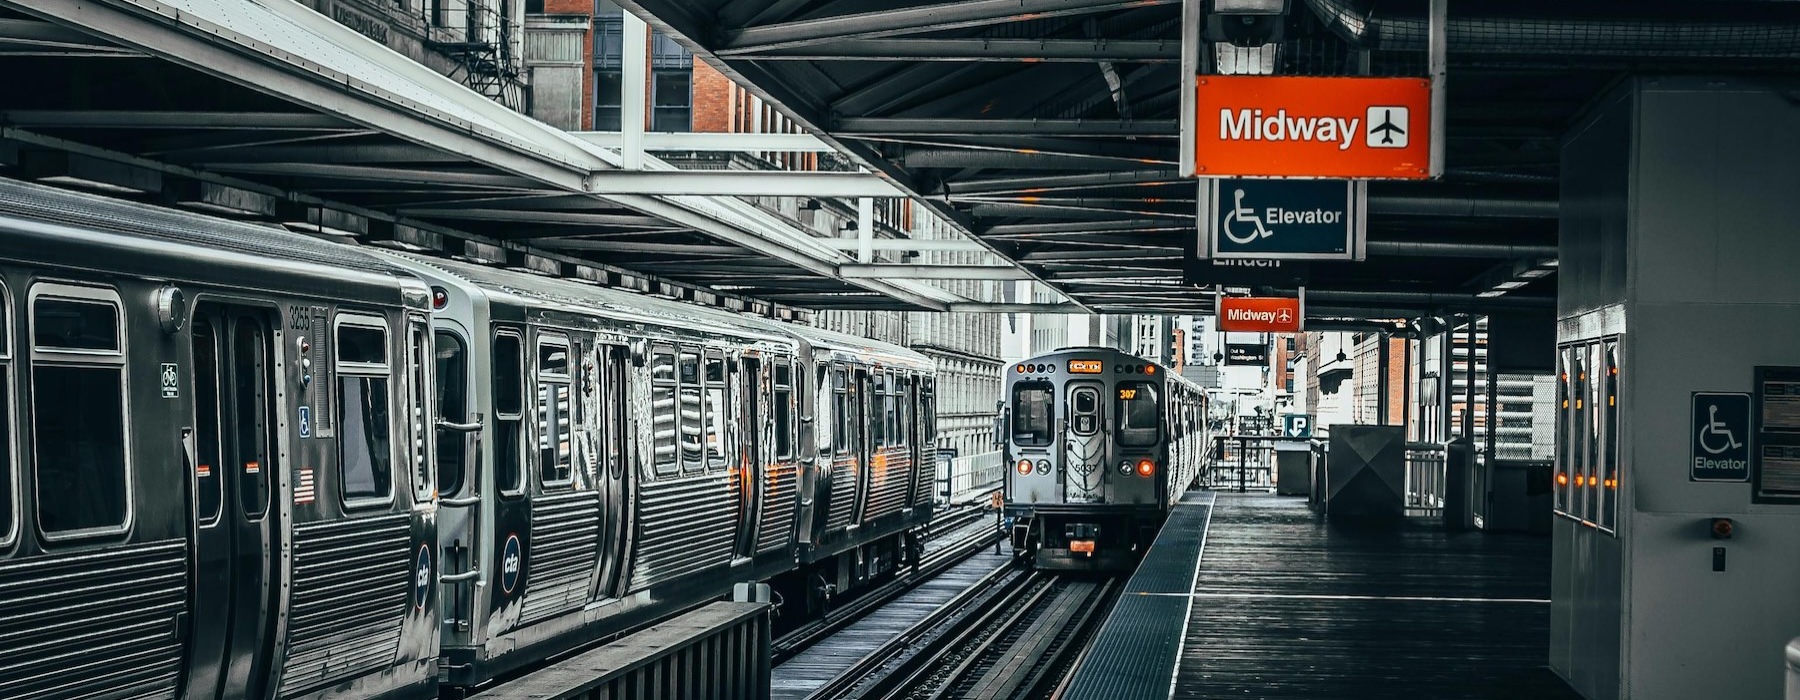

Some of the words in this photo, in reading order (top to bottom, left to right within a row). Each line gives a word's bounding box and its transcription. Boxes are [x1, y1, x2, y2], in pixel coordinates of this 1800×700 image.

[1219, 108, 1360, 150] Midway
[1267, 207, 1341, 225] Elevator
[289, 305, 310, 331] 3255
[1227, 308, 1277, 324] Midway
[1120, 389, 1136, 400] 307
[1075, 464, 1097, 473] 5037
[1695, 456, 1747, 470] Elevator
[504, 553, 518, 574] cta
[417, 564, 429, 588] cta
